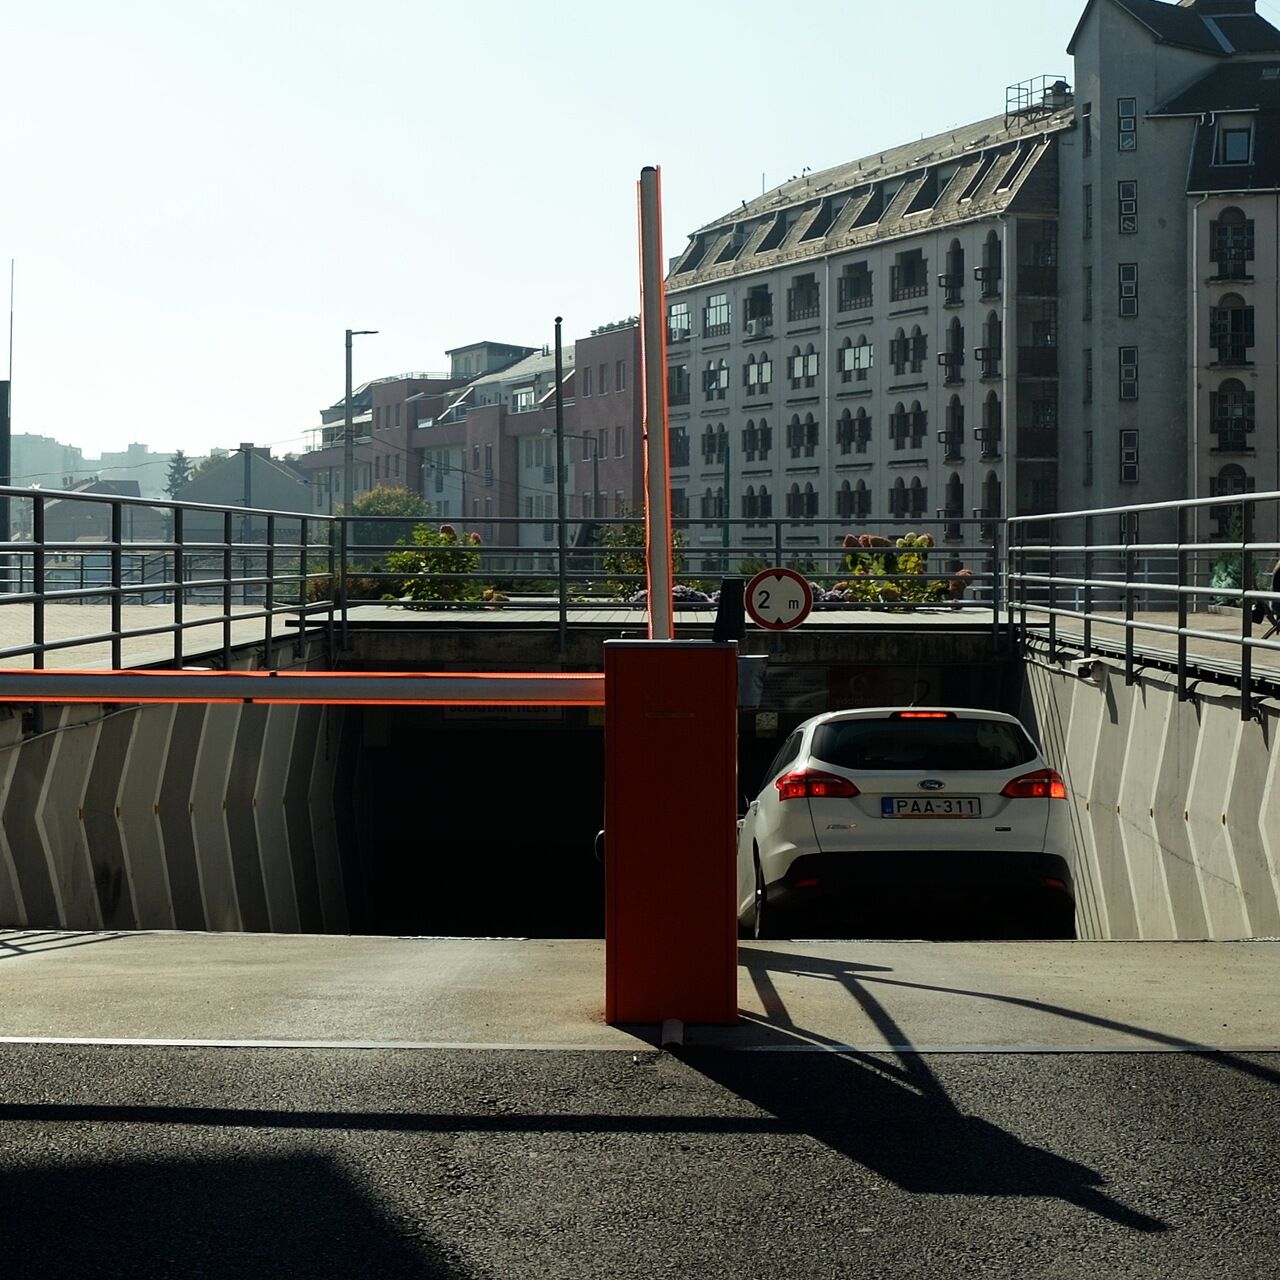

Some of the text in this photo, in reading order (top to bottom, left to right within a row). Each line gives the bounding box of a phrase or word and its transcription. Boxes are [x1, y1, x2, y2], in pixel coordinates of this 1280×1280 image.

[758, 590, 799, 609] 2 m
[897, 800, 974, 813] PAA-311
